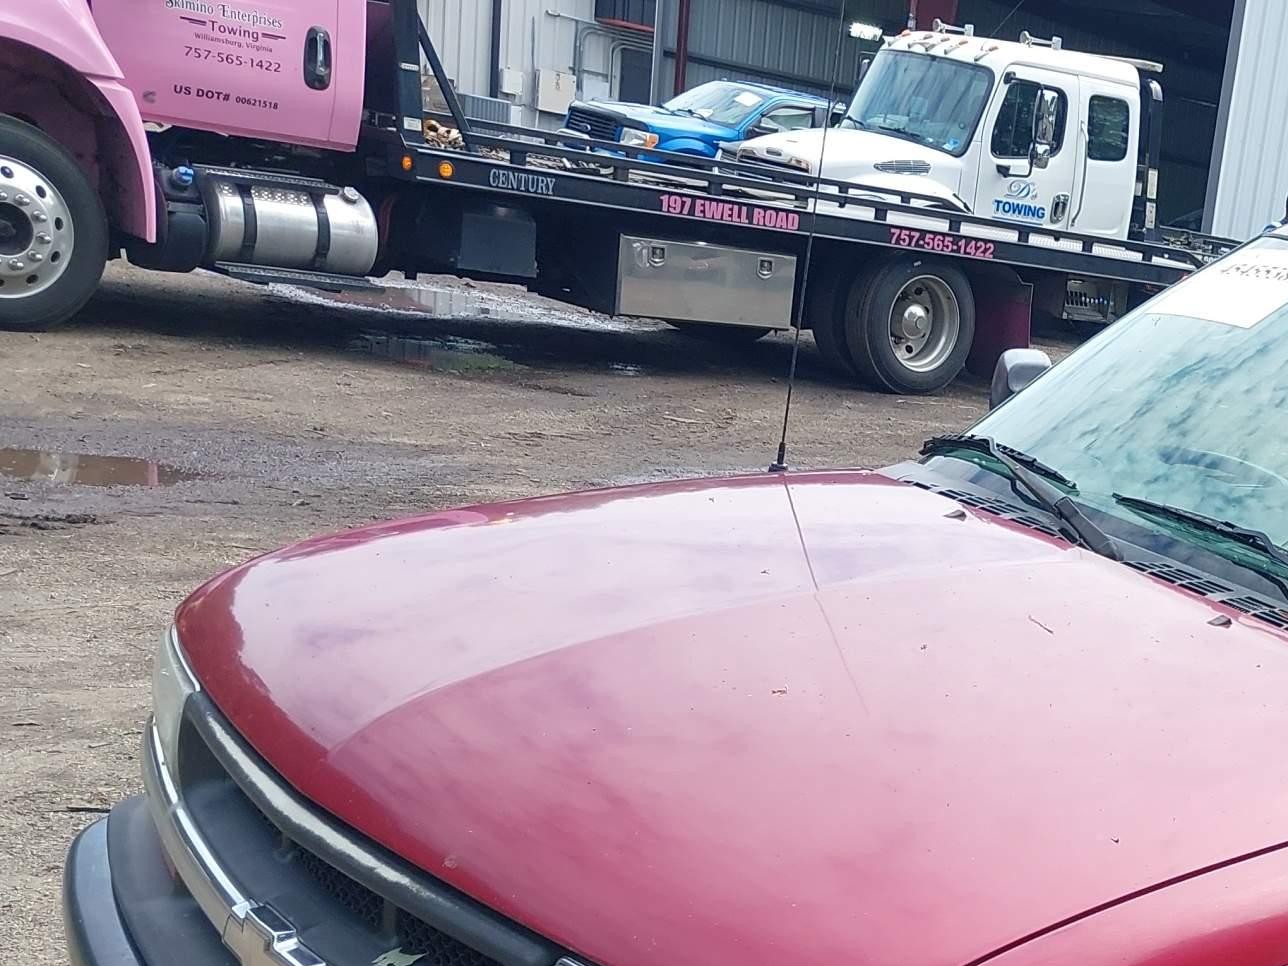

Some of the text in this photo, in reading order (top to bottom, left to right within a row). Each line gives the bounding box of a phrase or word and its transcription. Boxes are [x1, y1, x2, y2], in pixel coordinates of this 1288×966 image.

[218, 4, 283, 28] Enterprises
[194, 32, 273, 53] Williamsburg, Virginia
[208, 20, 260, 42] Towing
[184, 45, 281, 73] 757-565-1422
[174, 84, 279, 110] US DOT# 00621518
[489, 168, 556, 195] CENTURY
[659, 194, 799, 231] 197 EWELL ROAD
[994, 199, 1046, 219] TOWING
[890, 228, 994, 259] 757-565-1422
